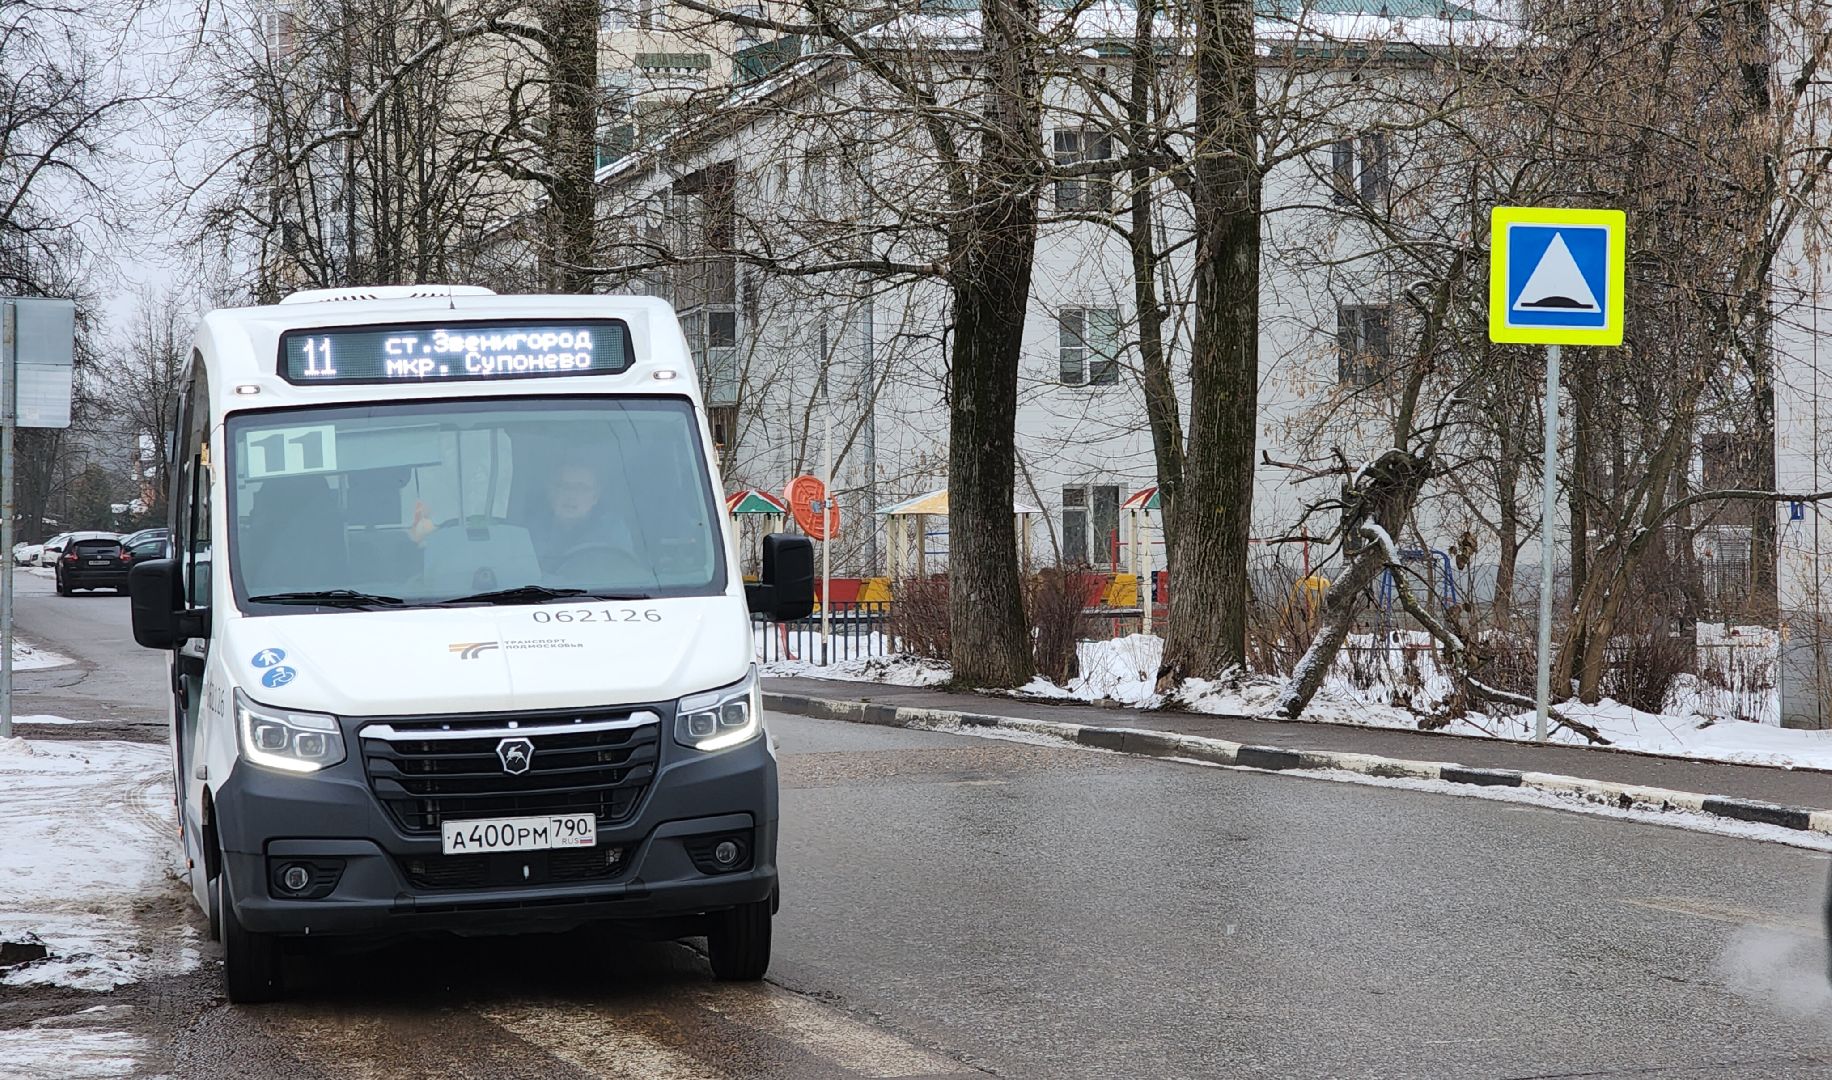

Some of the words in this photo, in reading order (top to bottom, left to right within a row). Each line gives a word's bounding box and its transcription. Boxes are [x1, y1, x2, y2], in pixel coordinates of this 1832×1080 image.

[303, 337, 337, 376] 11
[386, 357, 449, 377] мкр.
[465, 352, 591, 374] Супонево
[250, 431, 324, 473] 11
[532, 609, 662, 624] 062126
[452, 824, 548, 849] А400РМ
[552, 818, 588, 838] 790
[562, 837, 579, 845] RUS
